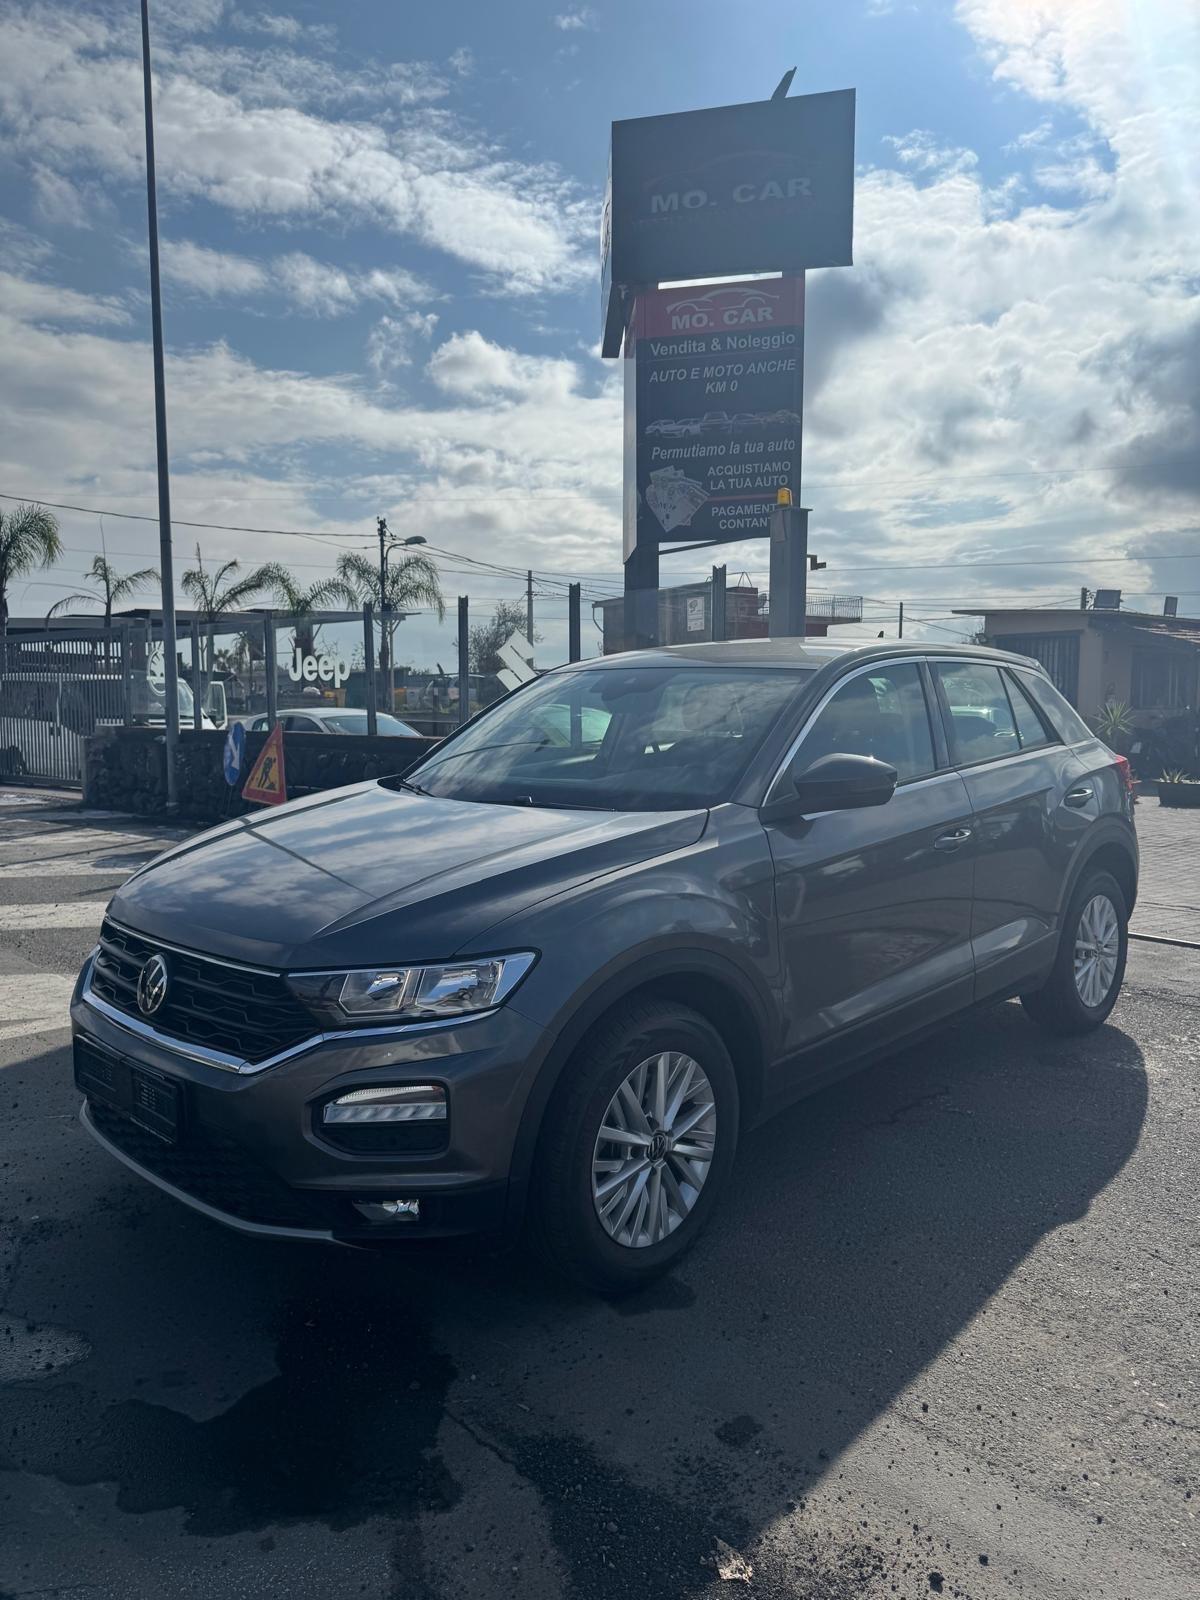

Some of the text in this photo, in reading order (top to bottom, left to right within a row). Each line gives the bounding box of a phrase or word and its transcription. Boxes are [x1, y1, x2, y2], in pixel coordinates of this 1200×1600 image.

[652, 177, 812, 213] MO. CAR
[671, 306, 774, 330] MO. CAR
[651, 332, 796, 357] Vendita & Noleggio
[649, 359, 796, 383] AUTO E MOTO ANCHE
[705, 381, 727, 394] KM
[652, 438, 795, 460] Permutiamo la tua auto
[707, 461, 791, 477] ACQUISTIAMO
[710, 475, 788, 490] LA TUA AUTO
[712, 503, 777, 517] PAGAMENT
[289, 647, 350, 689] Jeep
